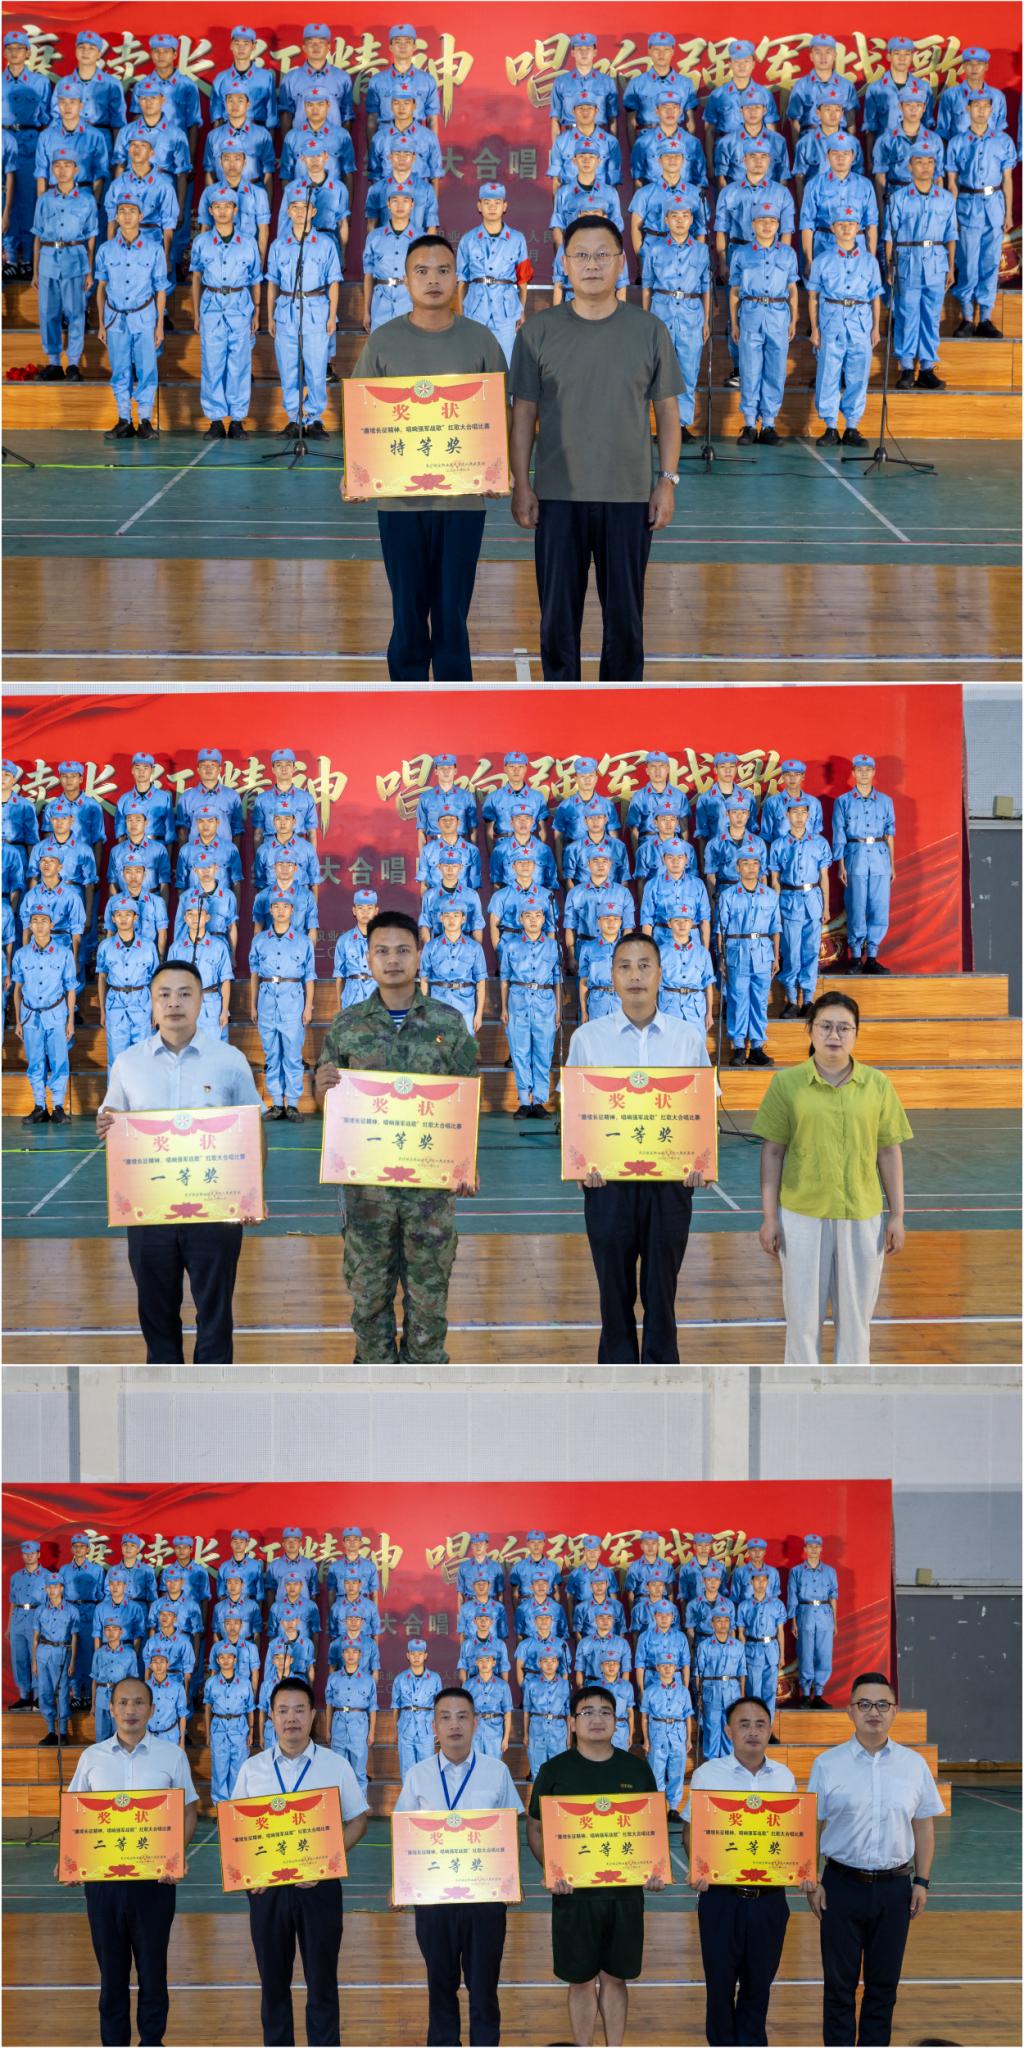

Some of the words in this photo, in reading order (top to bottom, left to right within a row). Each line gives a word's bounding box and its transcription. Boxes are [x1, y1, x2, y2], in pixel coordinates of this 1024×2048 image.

[442, 147, 545, 180] 大合唱
[392, 402, 460, 421] 奖状
[390, 437, 462, 457] 特等奖
[320, 856, 412, 885] 大合唱
[372, 1097, 436, 1116] 奖状
[608, 1093, 673, 1110] 奖状
[153, 1134, 217, 1152] 奖状
[366, 1131, 434, 1151] 一等奖
[605, 1125, 674, 1144] 一等奖
[150, 1167, 220, 1186] 一等奖
[380, 1612, 453, 1636] 大合唱
[97, 1811, 150, 1825] 奖状
[255, 1812, 307, 1831] 奖状
[579, 1815, 632, 1829] 奖状
[728, 1813, 782, 1827] 奖状
[93, 1836, 150, 1851] 二等奖
[430, 1831, 482, 1845] 奖状
[725, 1839, 782, 1855] 二等奖
[254, 1839, 310, 1856] 二等奖
[577, 1841, 635, 1857] 二等奖
[427, 1858, 484, 1873] 二等奖
